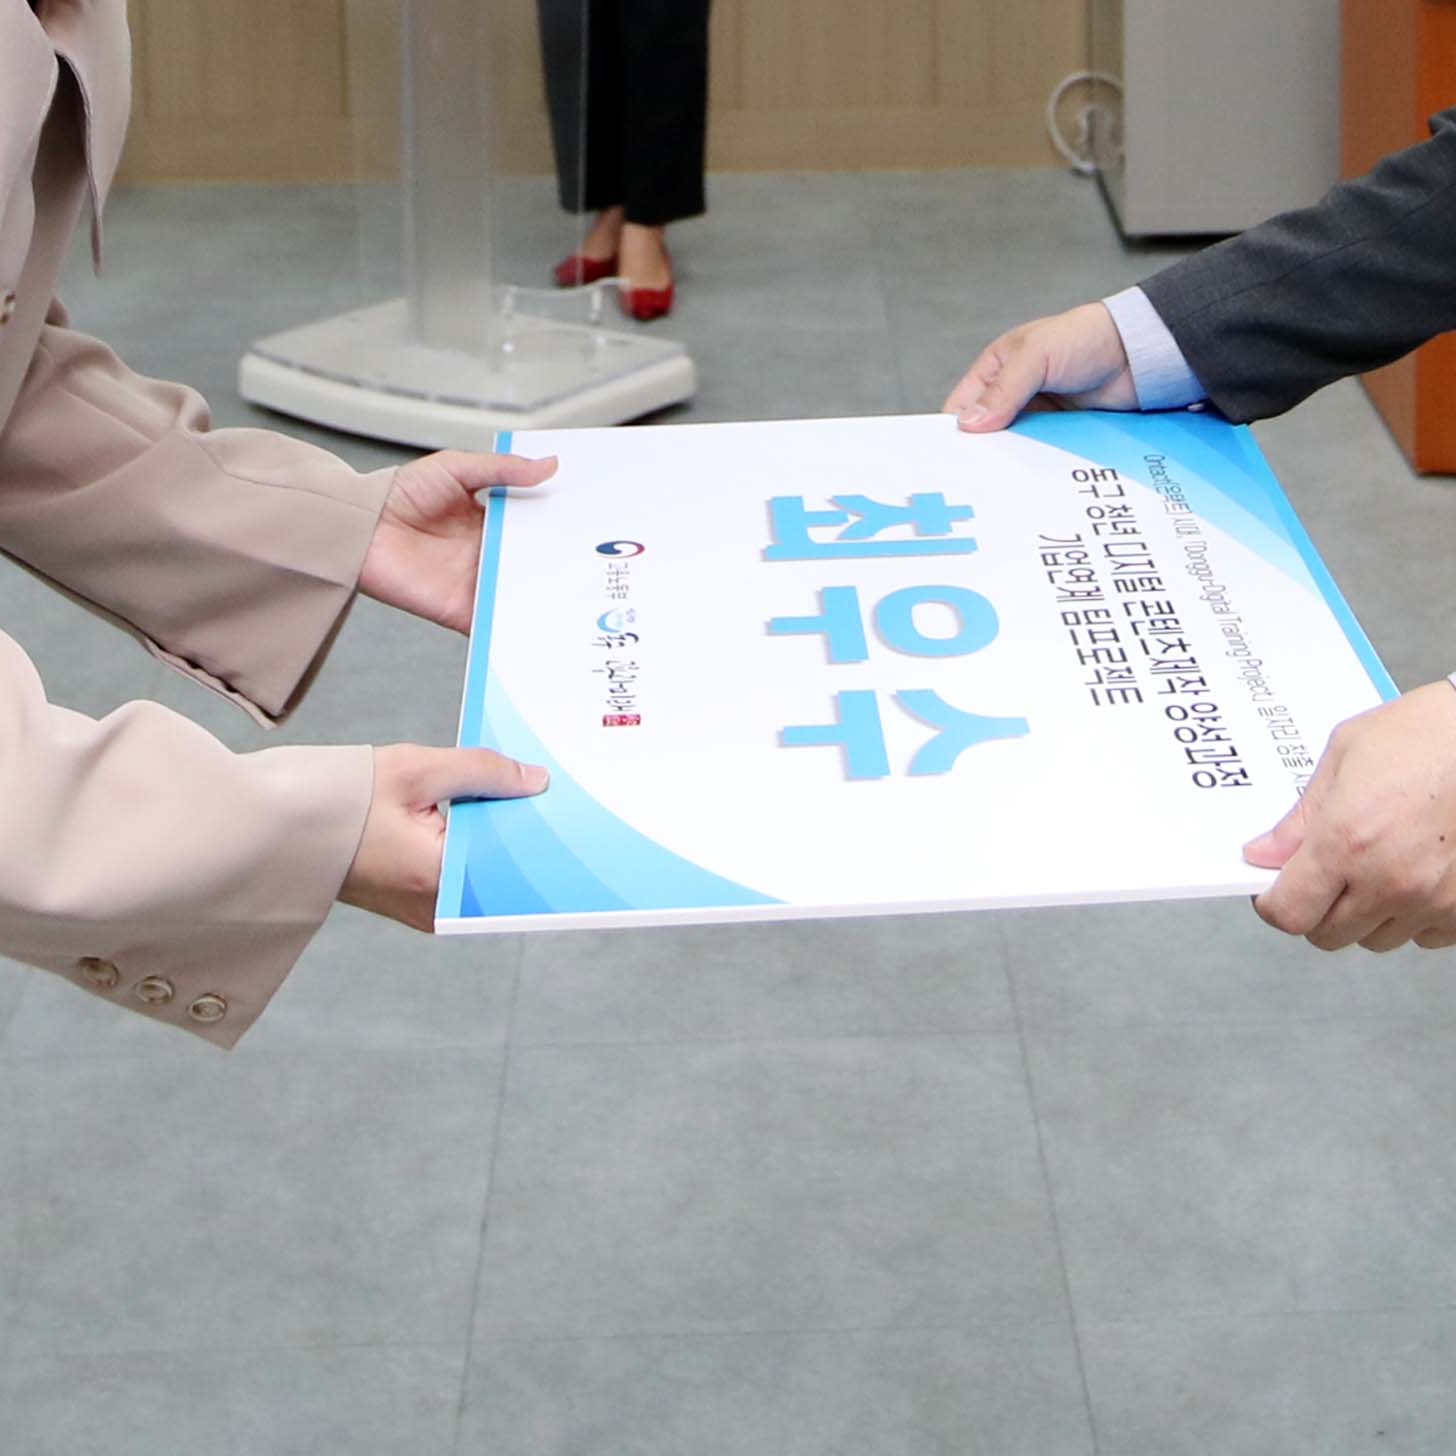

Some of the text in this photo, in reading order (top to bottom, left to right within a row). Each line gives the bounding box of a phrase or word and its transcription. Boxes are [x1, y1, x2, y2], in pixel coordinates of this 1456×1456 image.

[761, 492, 1030, 782] 최우수
[1038, 533, 1144, 706] 기업연계 팀프로젝트
[1072, 468, 1253, 789] 동구 청년 디지털 콘텐츠제작 양성과정
[1257, 705, 1301, 740] 일자리
[1276, 744, 1314, 768] 창출
